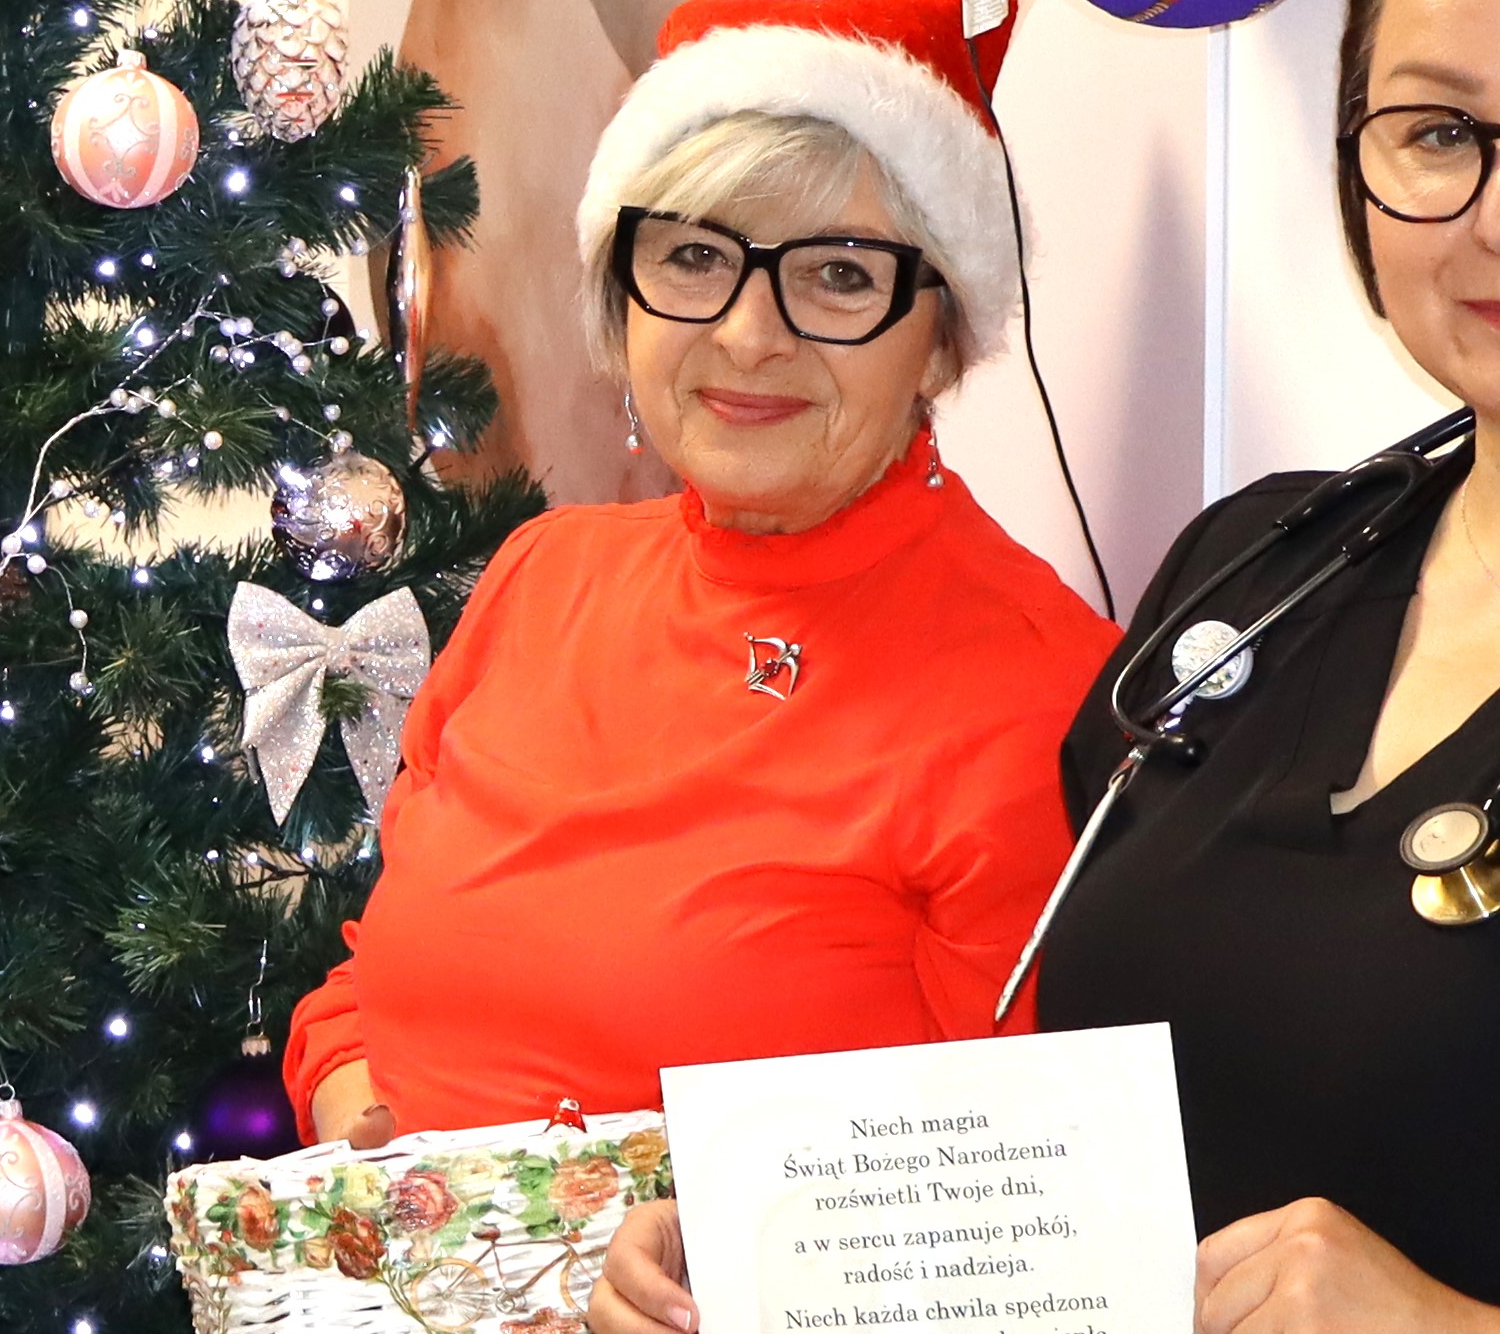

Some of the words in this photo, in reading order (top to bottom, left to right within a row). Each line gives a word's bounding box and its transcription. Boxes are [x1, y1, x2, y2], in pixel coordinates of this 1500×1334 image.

[849, 1115, 914, 1140] Niech
[920, 1109, 990, 1135] magia
[783, 1152, 845, 1181] Świąt
[852, 1152, 931, 1174] Bożego
[936, 1138, 1068, 1167] Narodzenia
[814, 1183, 922, 1212] rozświetli
[926, 1178, 994, 1204] Twoje
[1000, 1174, 1045, 1197] dni,
[794, 1240, 808, 1255] a
[812, 1238, 831, 1252] w
[838, 1233, 897, 1251] sercu
[902, 1220, 1004, 1249] zapanuje
[1010, 1214, 1078, 1243] pokój,
[843, 1260, 915, 1285] radość
[920, 1259, 929, 1280] i
[934, 1253, 1035, 1279] nadzieja.
[784, 1306, 848, 1330] Niech
[852, 1302, 920, 1326] każda
[925, 1296, 999, 1321] chwila
[1004, 1292, 1109, 1320] spędzona
